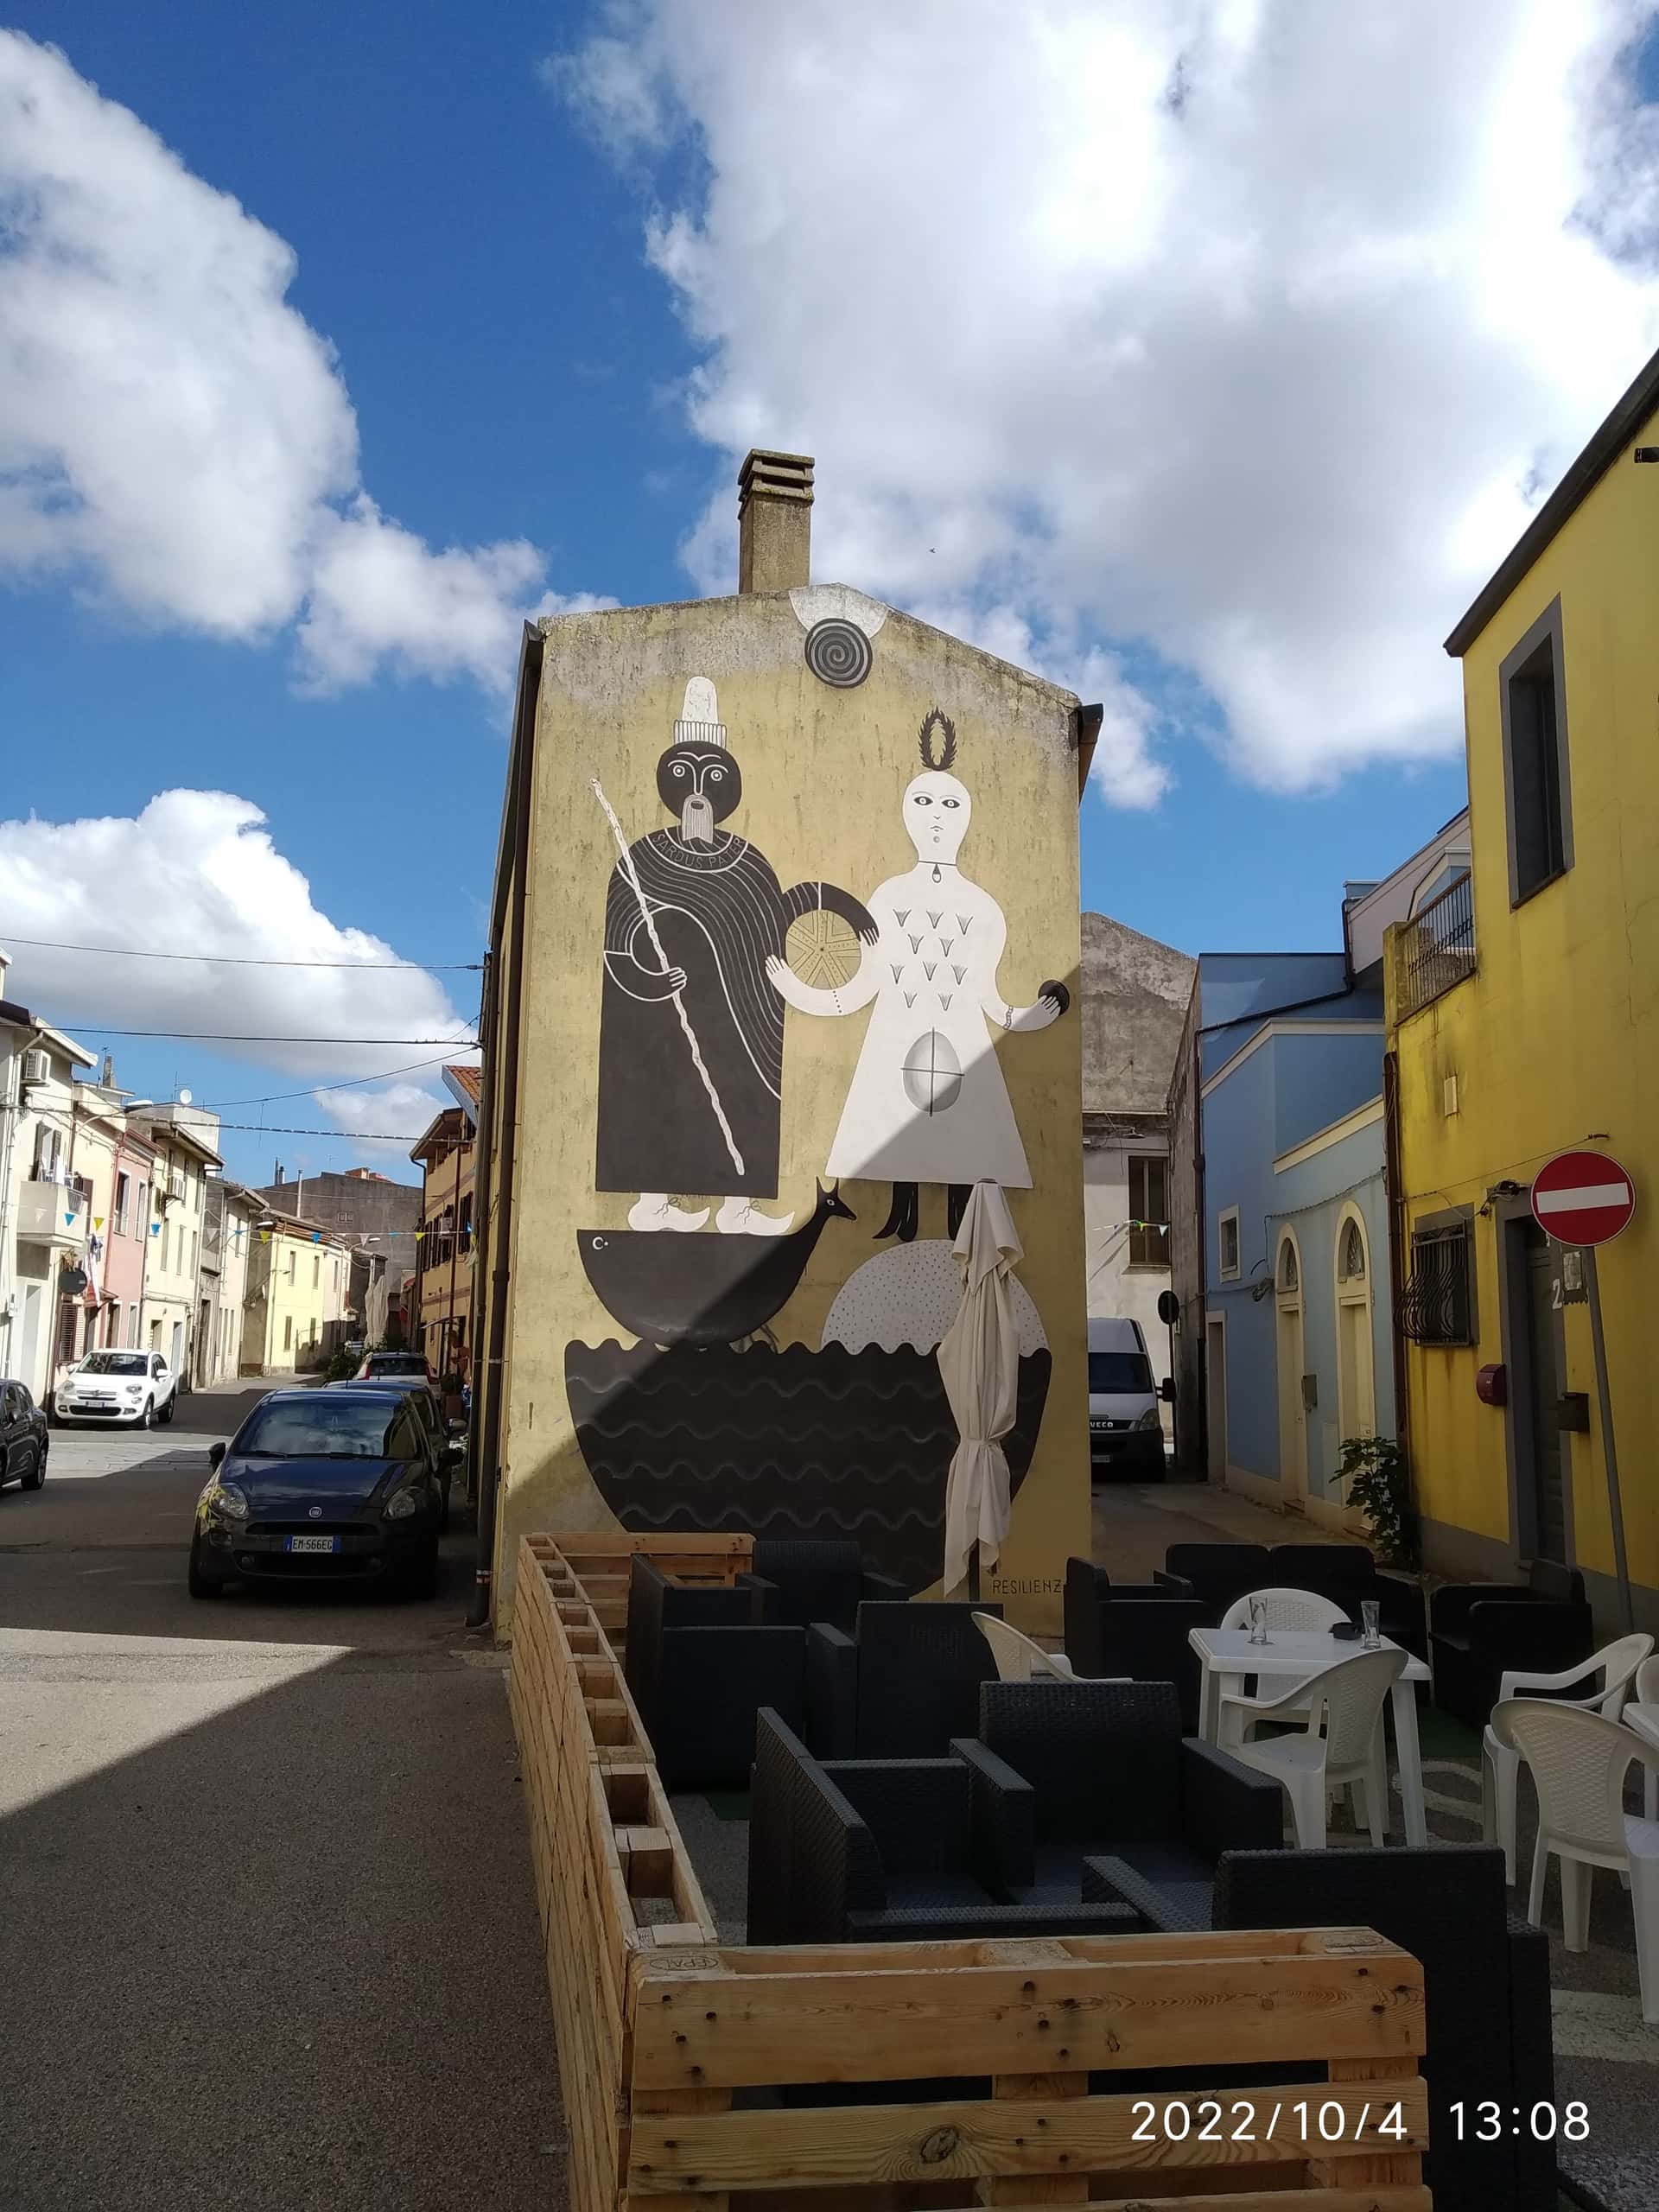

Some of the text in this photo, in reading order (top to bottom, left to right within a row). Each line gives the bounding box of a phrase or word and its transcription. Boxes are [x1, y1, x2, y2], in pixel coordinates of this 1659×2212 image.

[652, 833, 745, 869] SARDUS PATER
[992, 1579, 1062, 1594] RESILIENZ
